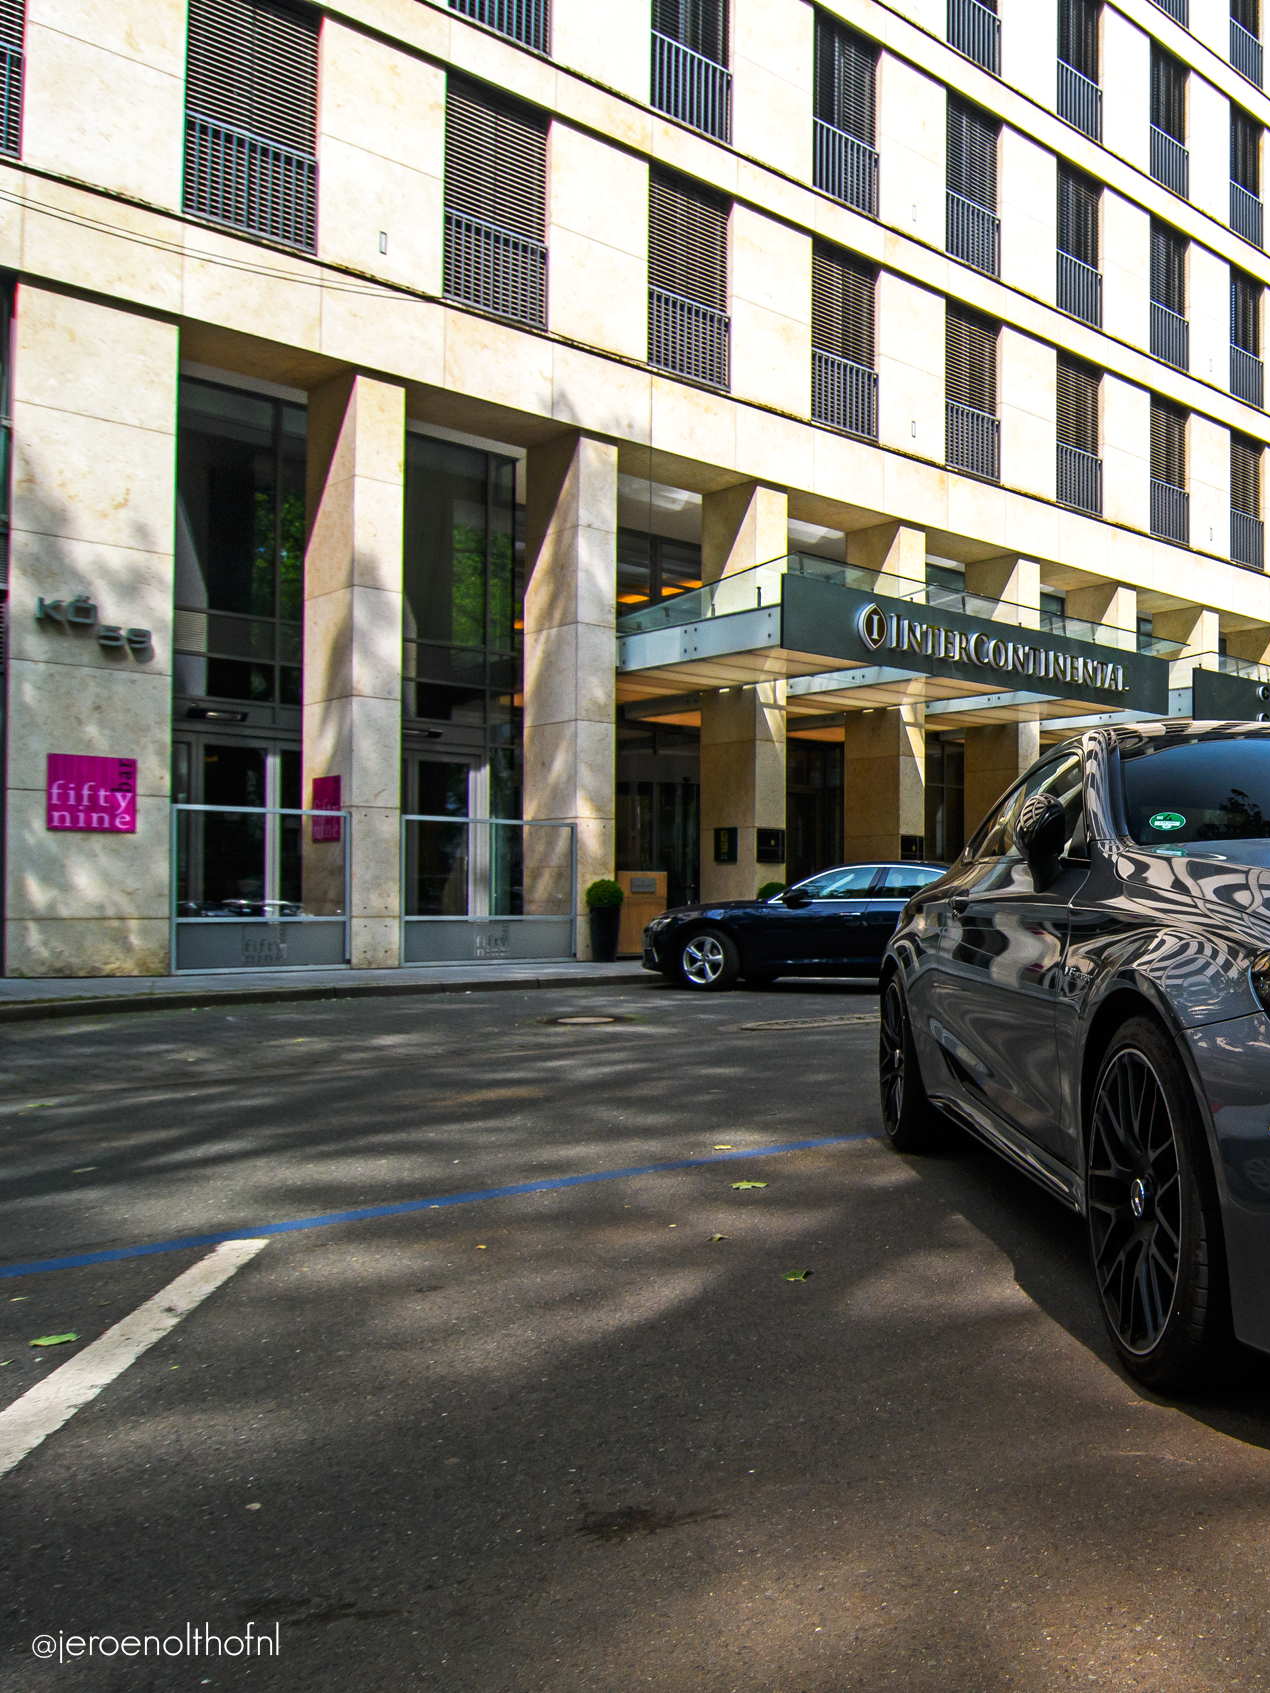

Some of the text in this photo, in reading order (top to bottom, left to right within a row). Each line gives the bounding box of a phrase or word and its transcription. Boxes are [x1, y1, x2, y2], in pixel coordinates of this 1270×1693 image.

[98, 625, 152, 649] 59
[111, 760, 134, 793] bar
[50, 780, 133, 813] fifty
[51, 806, 131, 829] nine
